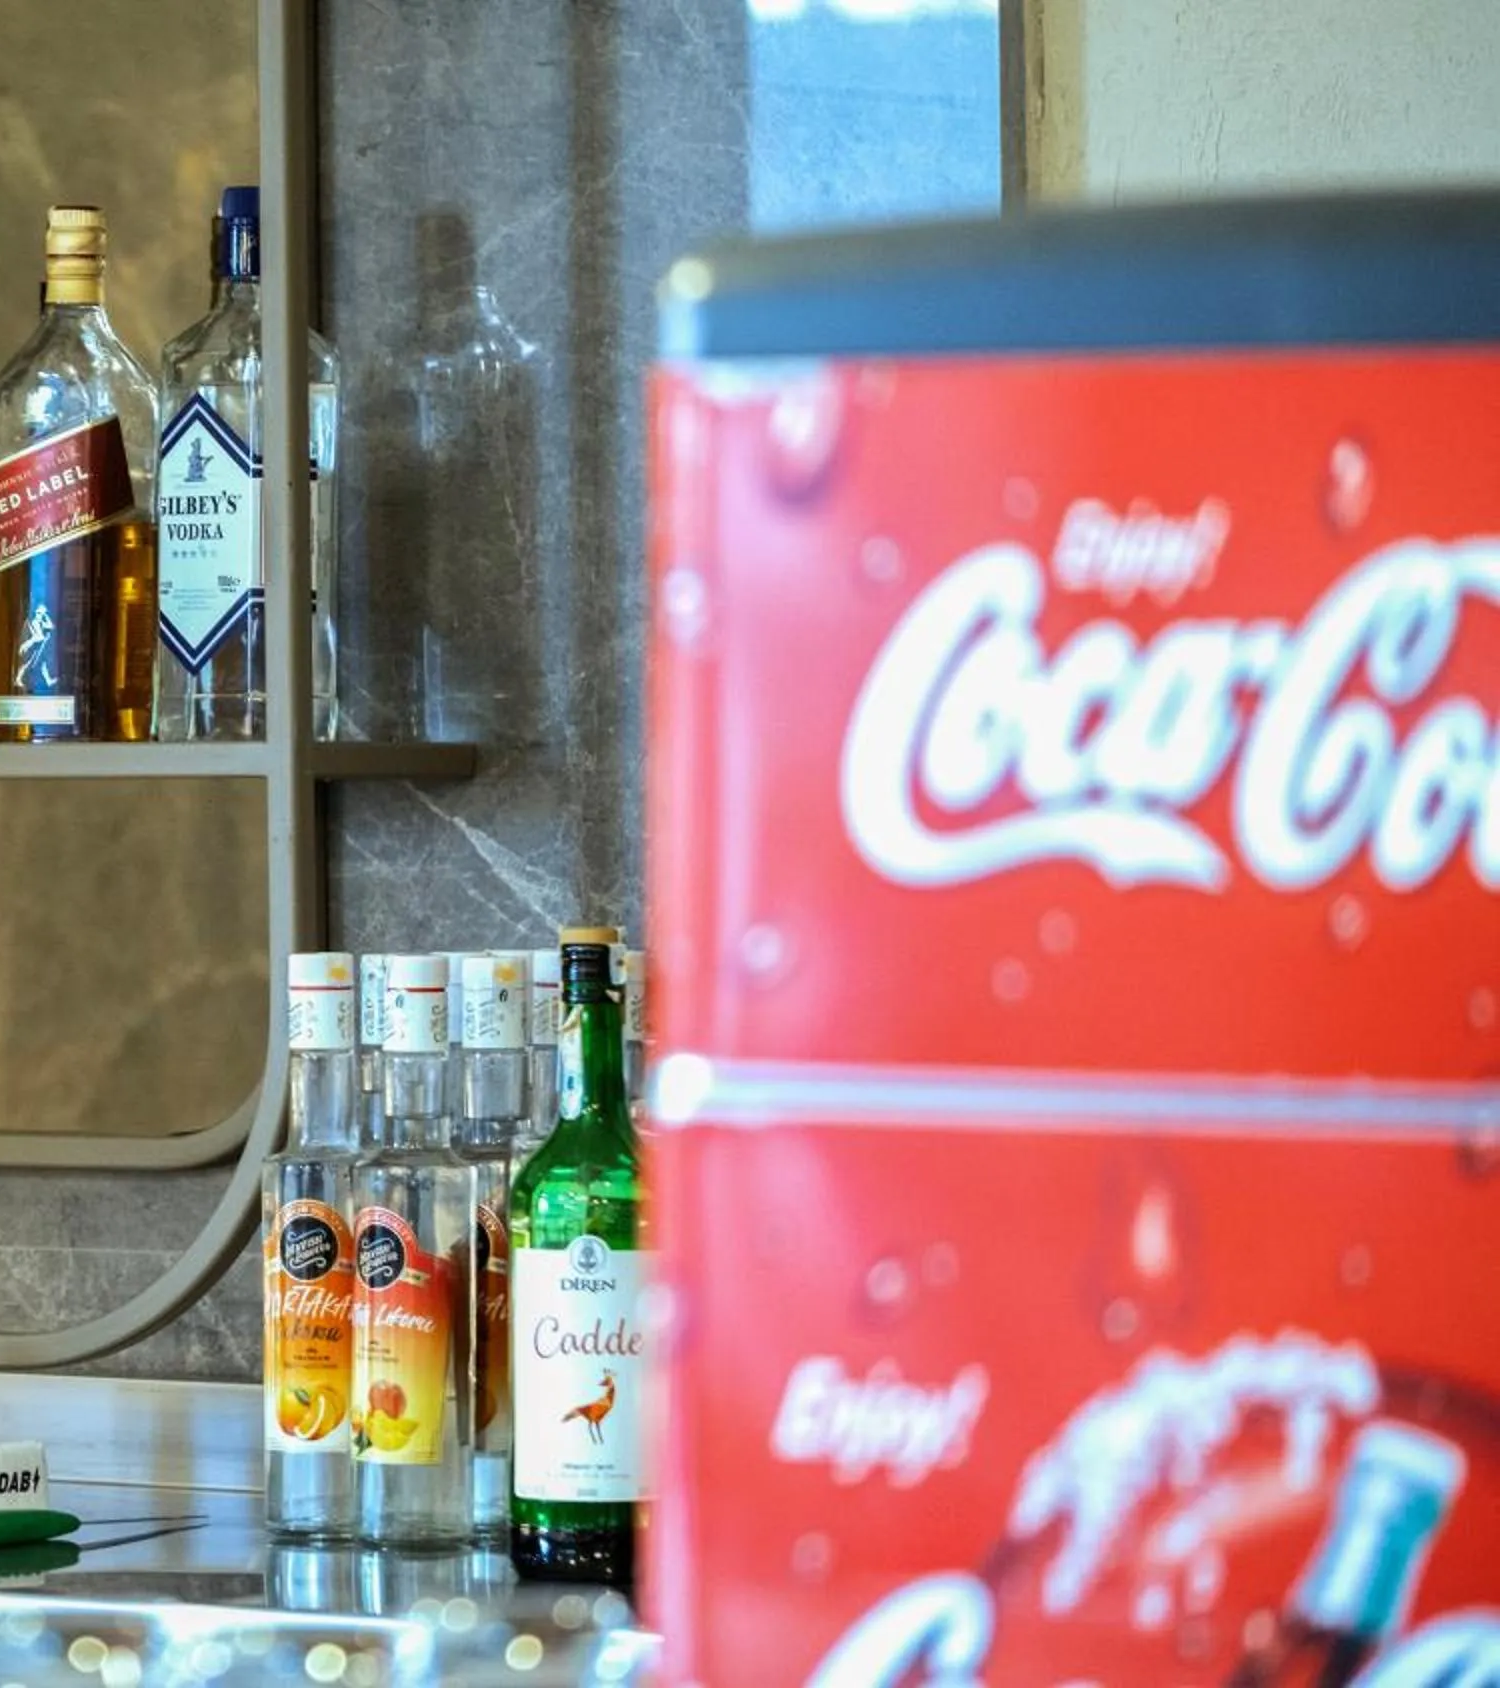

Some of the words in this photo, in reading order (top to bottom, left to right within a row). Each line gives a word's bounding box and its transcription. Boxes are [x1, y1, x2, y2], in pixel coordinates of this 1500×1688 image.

[25, 465, 89, 502] LABEL
[167, 523, 224, 541] VODKA
[533, 1315, 644, 1359] Cadde
